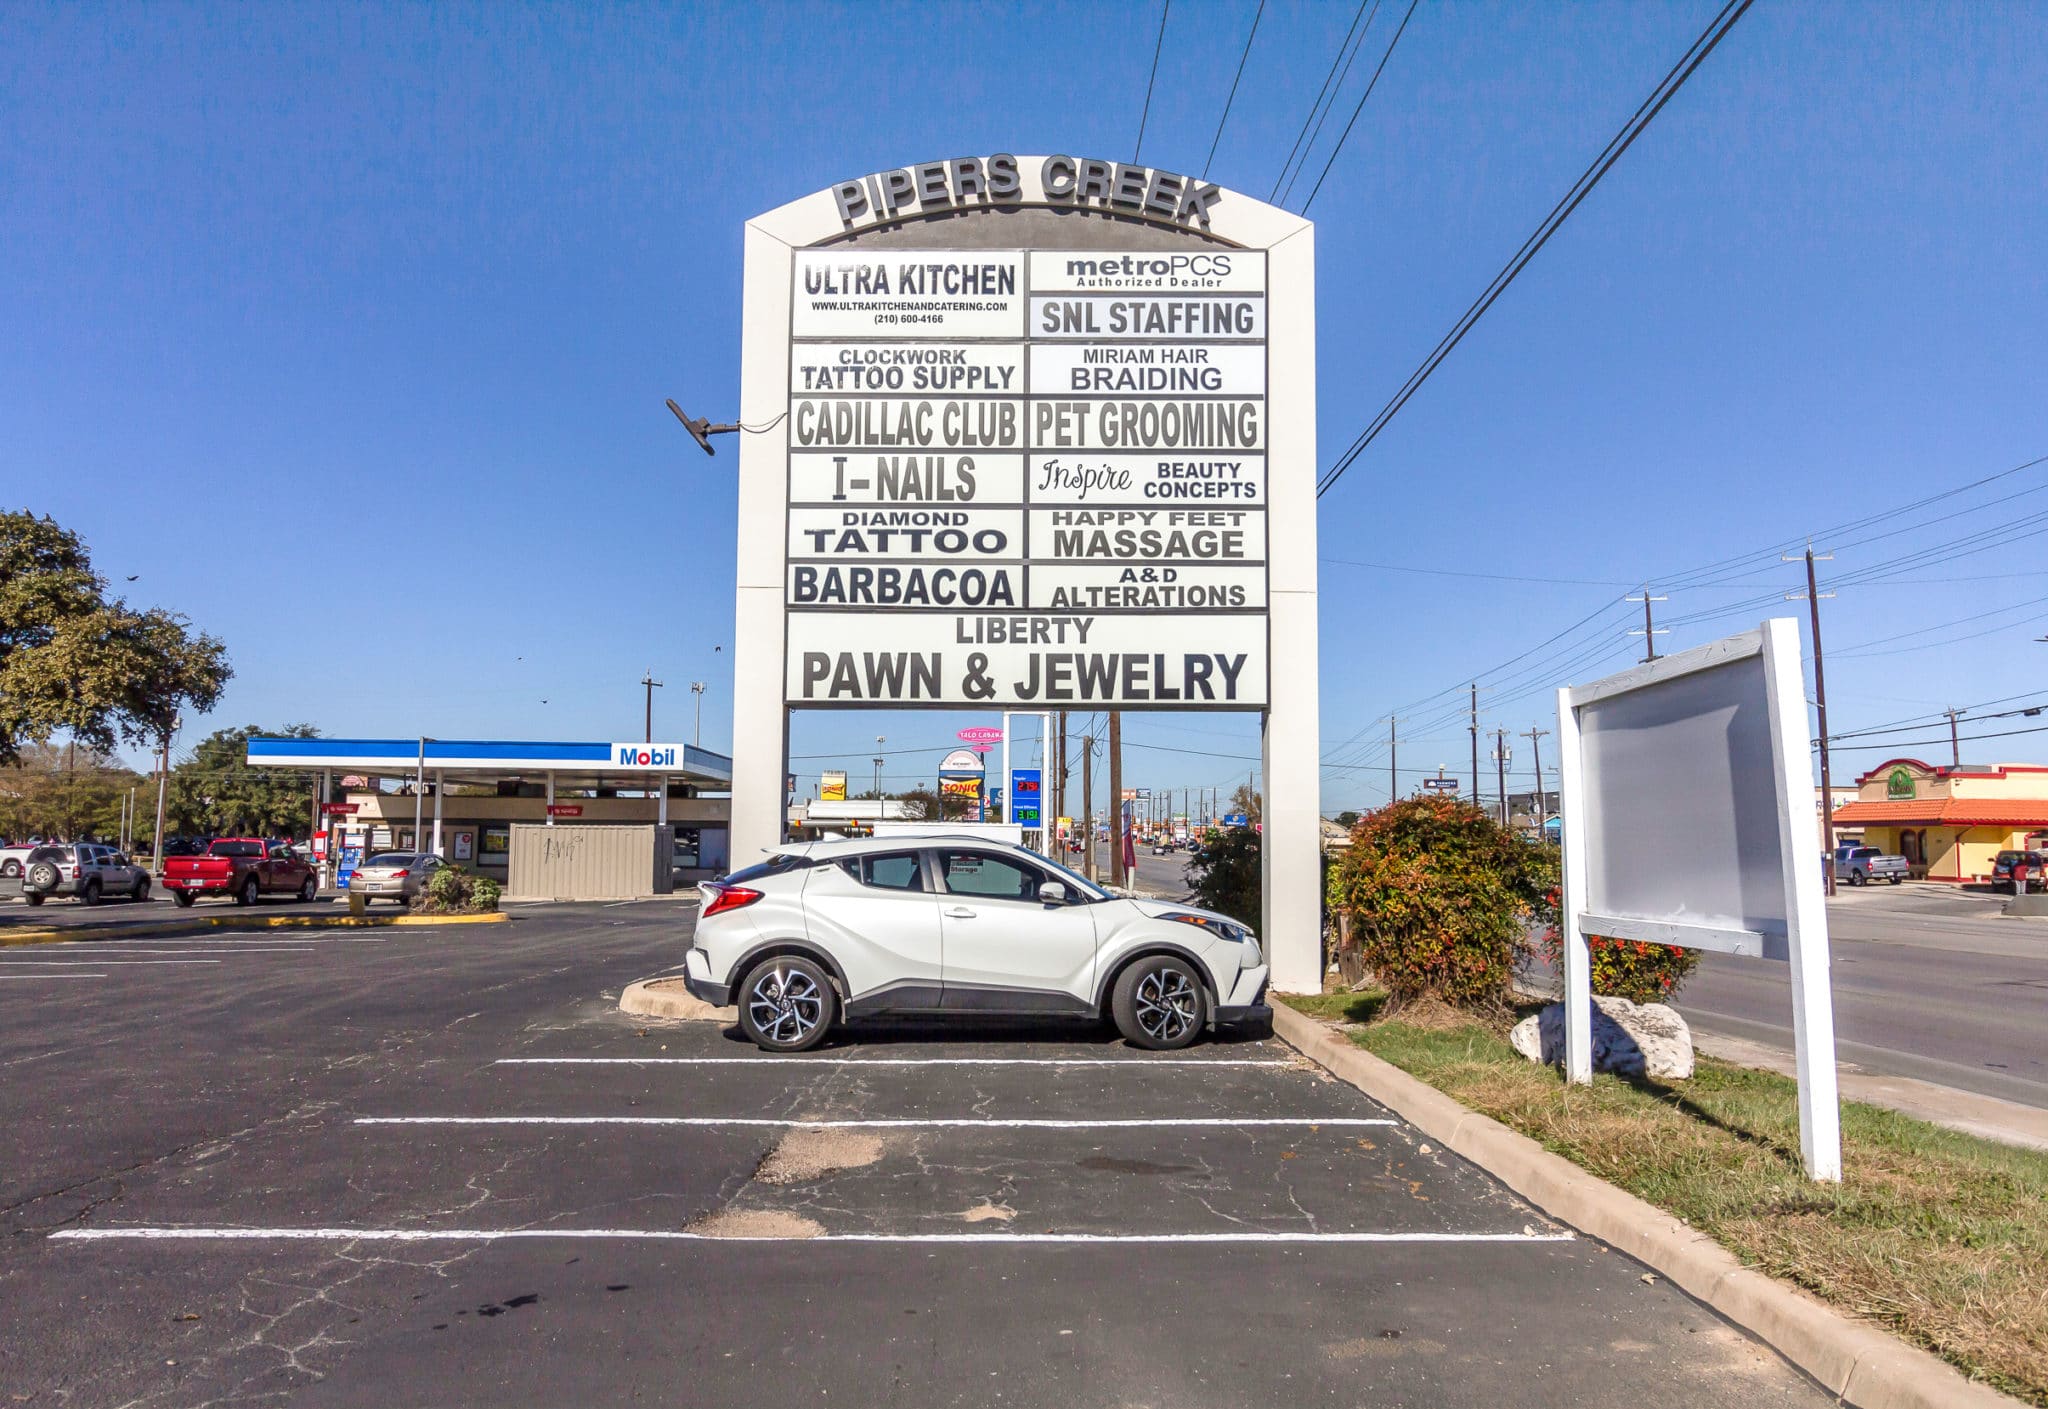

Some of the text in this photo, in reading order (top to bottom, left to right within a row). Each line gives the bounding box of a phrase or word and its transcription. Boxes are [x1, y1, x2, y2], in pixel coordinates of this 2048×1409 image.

[832, 153, 1221, 226] PIPERS CREEK
[1066, 255, 1232, 276] metroPCS
[805, 264, 1015, 295] ULTRA KITCHEN
[1077, 277, 1222, 287] Authorized Dealer
[812, 302, 1007, 311] WWW.ULTRAKITCHENANDCATERING.COM
[874, 315, 943, 325] (210) 600-4166
[1043, 302, 1254, 334] SNL STAFFING
[839, 349, 966, 365] CLOCKWORK
[1083, 349, 1209, 364] MIRIAM HAIR
[801, 366, 1015, 390] TATTOO SUPPLY
[1071, 368, 1222, 391] BRAIDING
[797, 401, 1016, 447] CADILLAC CLUB
[1036, 402, 1257, 448] PET GROOMING
[1038, 459, 1133, 500] Inspire
[1157, 462, 1242, 479] BEAUTY
[1143, 482, 1257, 498] CONCEPTS
[842, 512, 969, 526] DIAMOND
[1052, 511, 1246, 526] HAPPY FEET
[804, 529, 1008, 554] TATTOO
[1054, 530, 1244, 558] MASSAGE
[794, 566, 1015, 606] BARBACOA
[1119, 568, 1178, 583] A&D
[1050, 585, 1247, 607] ALTERATIONS
[956, 617, 1094, 644] LIBERTY
[803, 652, 1248, 701] PAWN & JEWELRY
[619, 748, 675, 766] Mobil
[943, 783, 978, 793] SONIC
